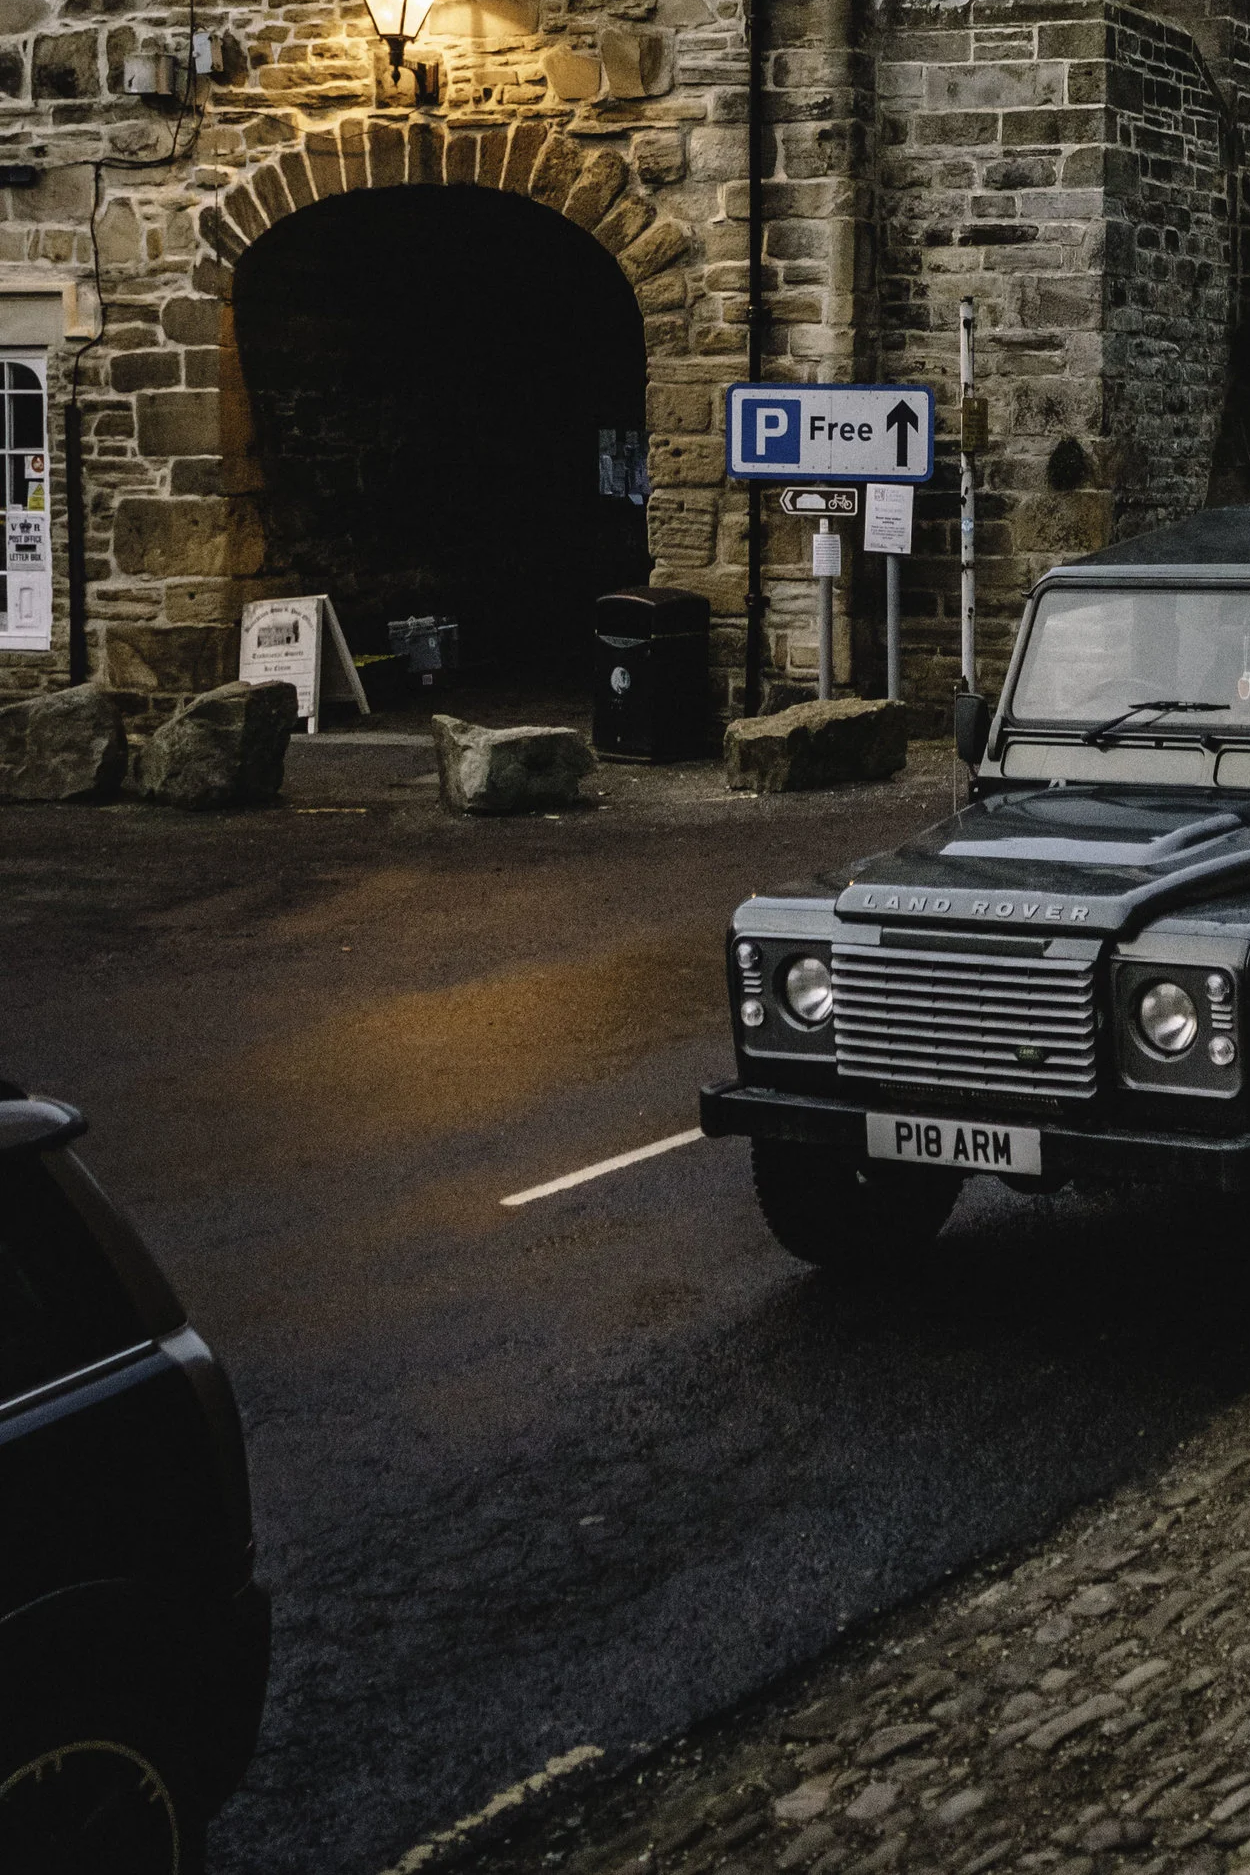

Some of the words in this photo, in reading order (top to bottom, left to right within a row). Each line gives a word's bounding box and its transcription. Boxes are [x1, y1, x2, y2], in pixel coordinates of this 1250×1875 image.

[756, 407, 789, 456] P
[809, 415, 873, 442] Free
[11, 523, 17, 531] V
[33, 523, 41, 532] R
[8, 535, 22, 543] POST
[24, 535, 42, 543] OFFICE
[9, 553, 29, 562] LETTER
[861, 892, 953, 915] LAND
[971, 900, 1092, 923] ROVER
[894, 1121, 943, 1158] P18
[953, 1127, 1012, 1167] ARM
